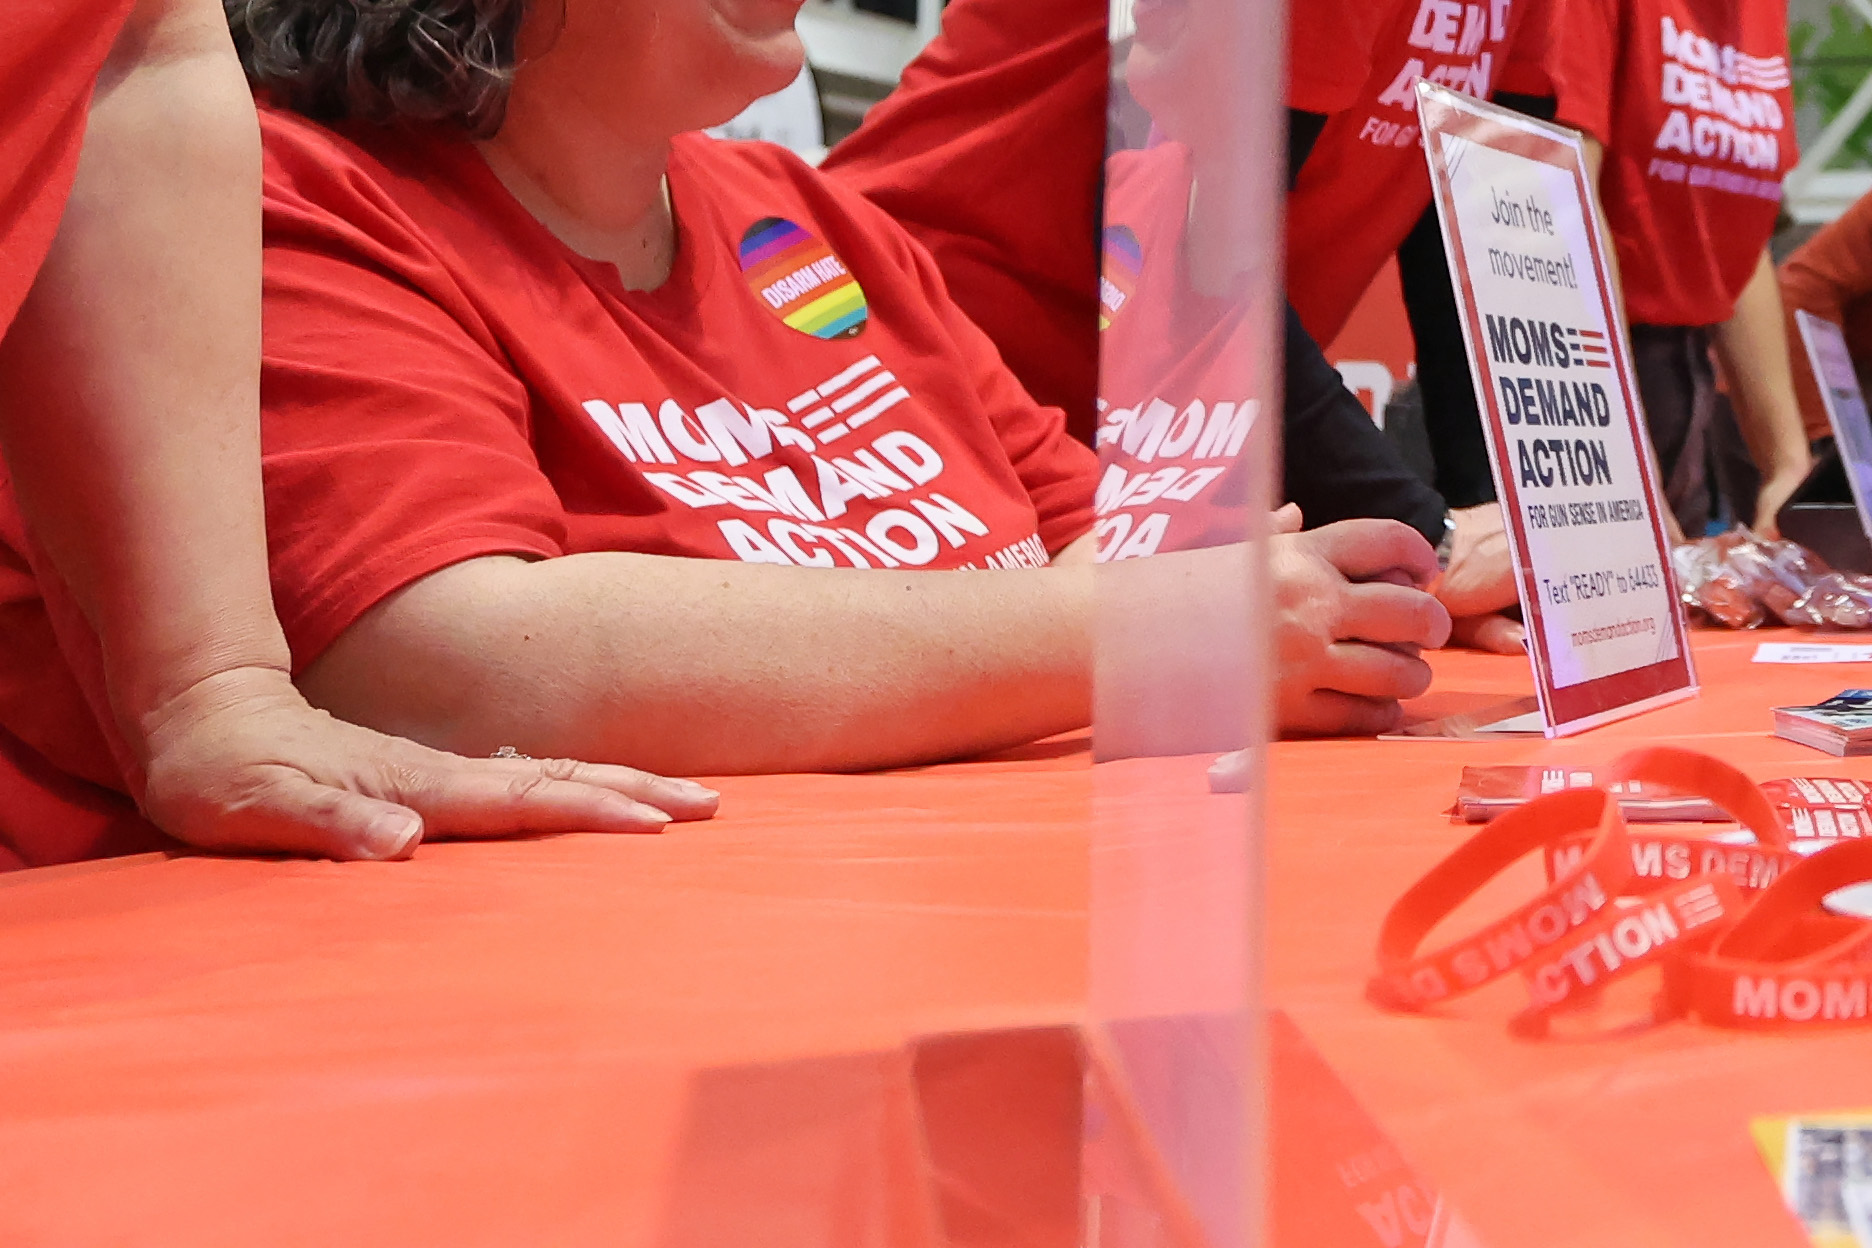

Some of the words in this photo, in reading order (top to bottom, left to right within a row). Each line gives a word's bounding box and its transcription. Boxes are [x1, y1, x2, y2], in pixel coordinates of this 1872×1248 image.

[1491, 185, 1526, 229] Join
[1526, 194, 1555, 236] the
[760, 264, 823, 309] DISARM
[810, 255, 847, 284] HATE
[1488, 247, 1578, 289] movement!
[1485, 313, 1570, 369] MOMS
[1499, 376, 1611, 427] DEMAND
[581, 397, 816, 467] MOMS
[641, 429, 944, 522] DEMAND
[1517, 439, 1613, 488] ACTION
[717, 493, 990, 570] ACTION
[1527, 505, 1549, 529] FOR
[1549, 503, 1570, 528] GUN
[1569, 502, 1598, 527] SENSE
[1597, 501, 1608, 524] IN
[1608, 499, 1644, 523] AMERICA
[1543, 579, 1571, 605] Text
[1616, 573, 1628, 594] to
